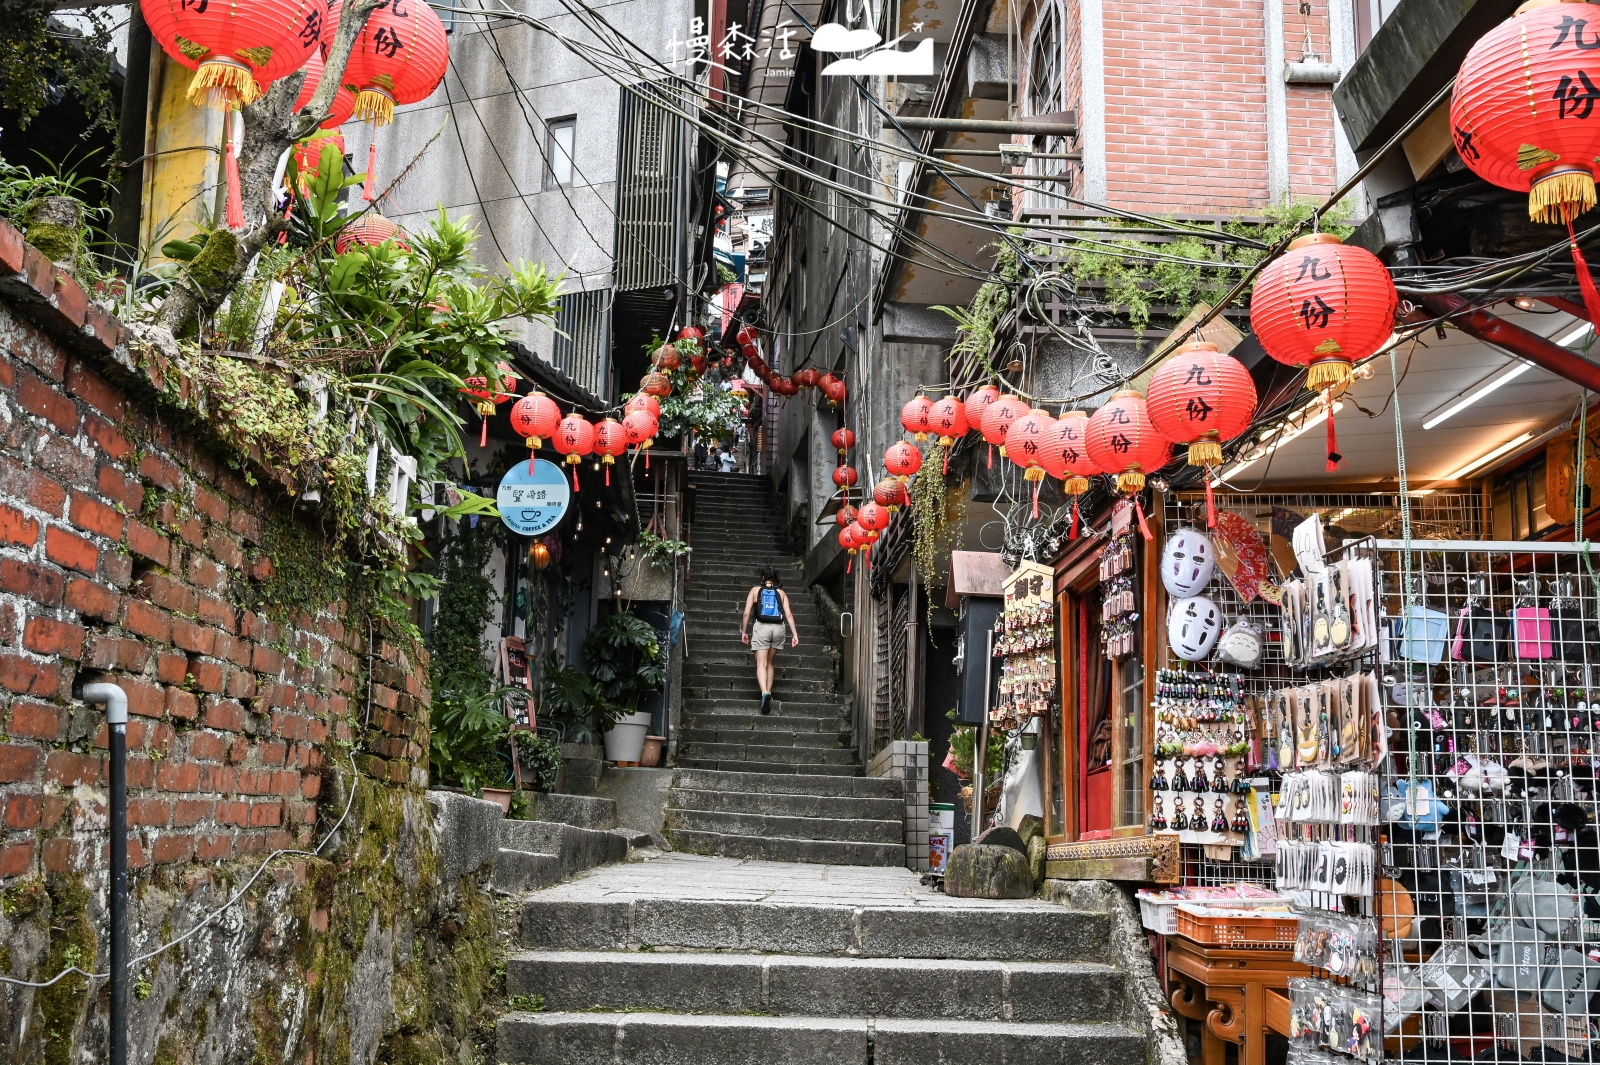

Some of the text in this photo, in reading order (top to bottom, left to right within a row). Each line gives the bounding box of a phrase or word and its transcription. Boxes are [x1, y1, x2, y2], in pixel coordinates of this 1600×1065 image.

[1549, 15, 1600, 120] 九份
[1295, 256, 1336, 330] 九份
[1184, 364, 1213, 421] 九份
[521, 400, 532, 426] 九份
[920, 405, 929, 427] 九份
[941, 405, 954, 429] 九份
[565, 421, 577, 446] 九份
[598, 426, 608, 447] 九份
[1023, 420, 1038, 456] 九份
[1108, 408, 1132, 453] 九份
[1060, 426, 1080, 464] 九份
[901, 448, 910, 469] 九份
[545, 514, 556, 525] TEA
